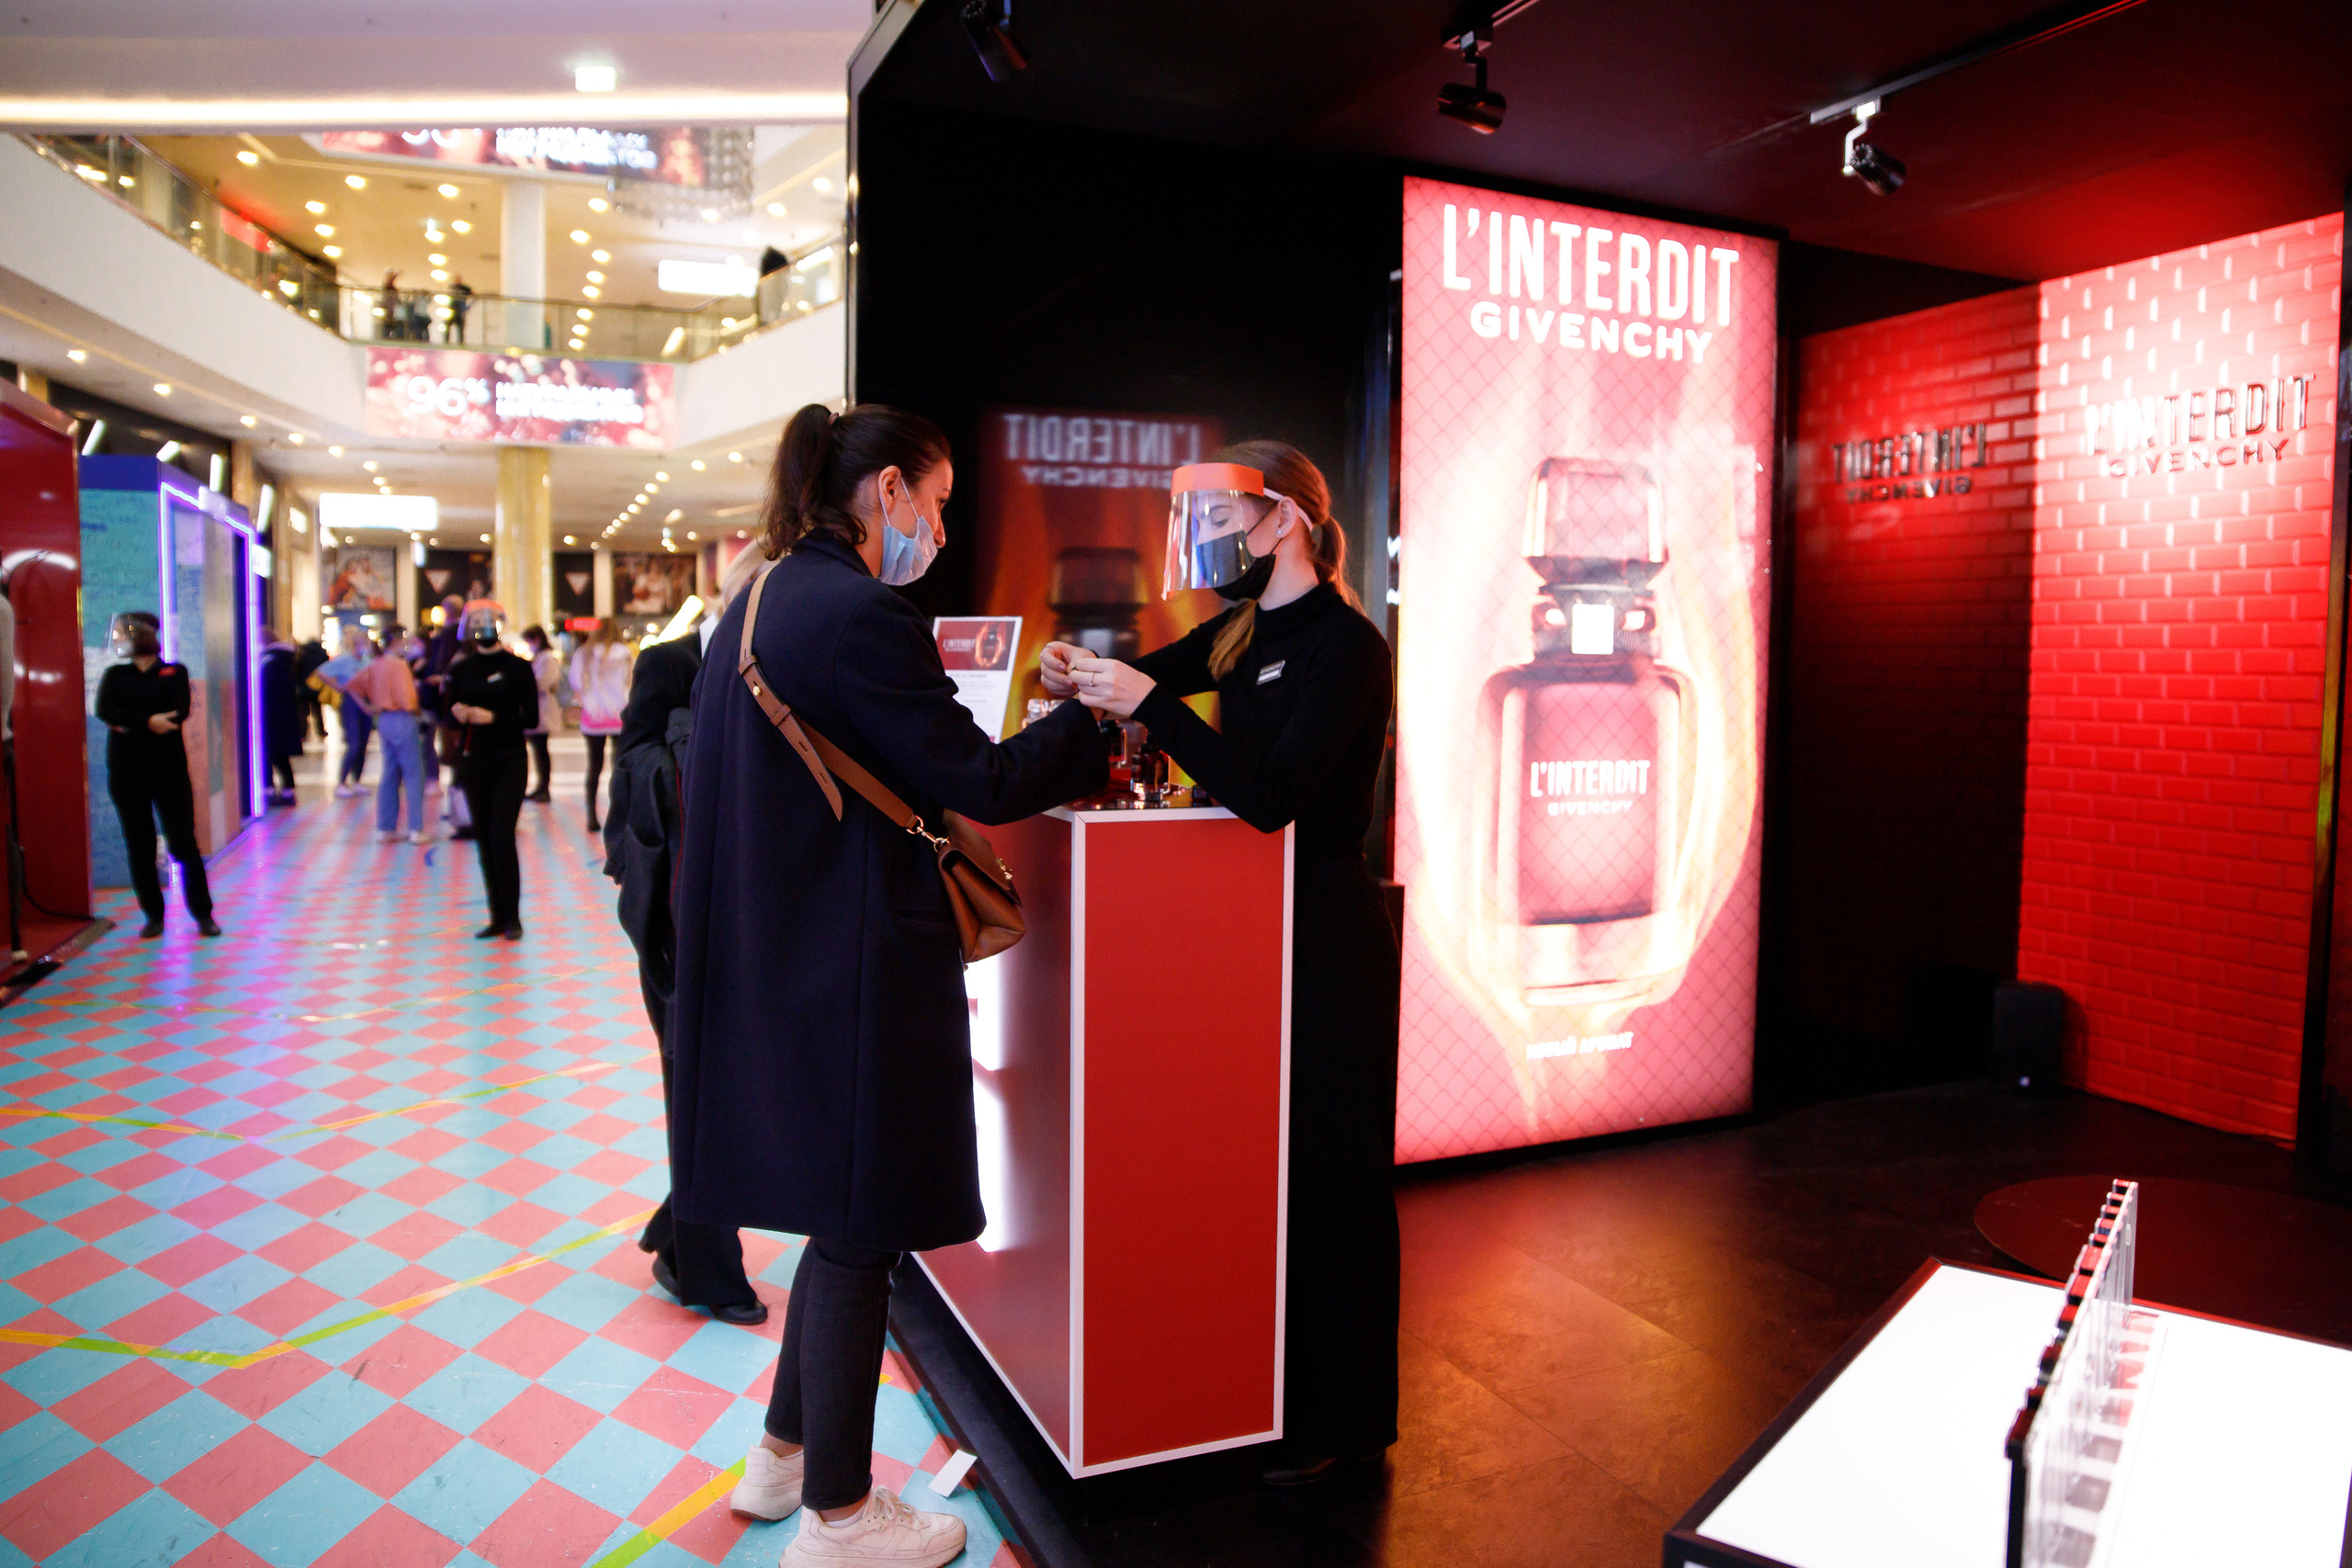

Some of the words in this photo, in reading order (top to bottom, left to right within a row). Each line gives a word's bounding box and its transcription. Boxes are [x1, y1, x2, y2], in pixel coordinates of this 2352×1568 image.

[1443, 204, 1739, 326] L'INTERDIT
[1470, 301, 1713, 364] GIVENCHY
[2084, 374, 2316, 455] L'INTERDIT
[2107, 437, 2290, 478] GIVENCHY
[1531, 760, 1651, 797] L'INTERDIT
[1547, 800, 1634, 816] GIVENCHY
